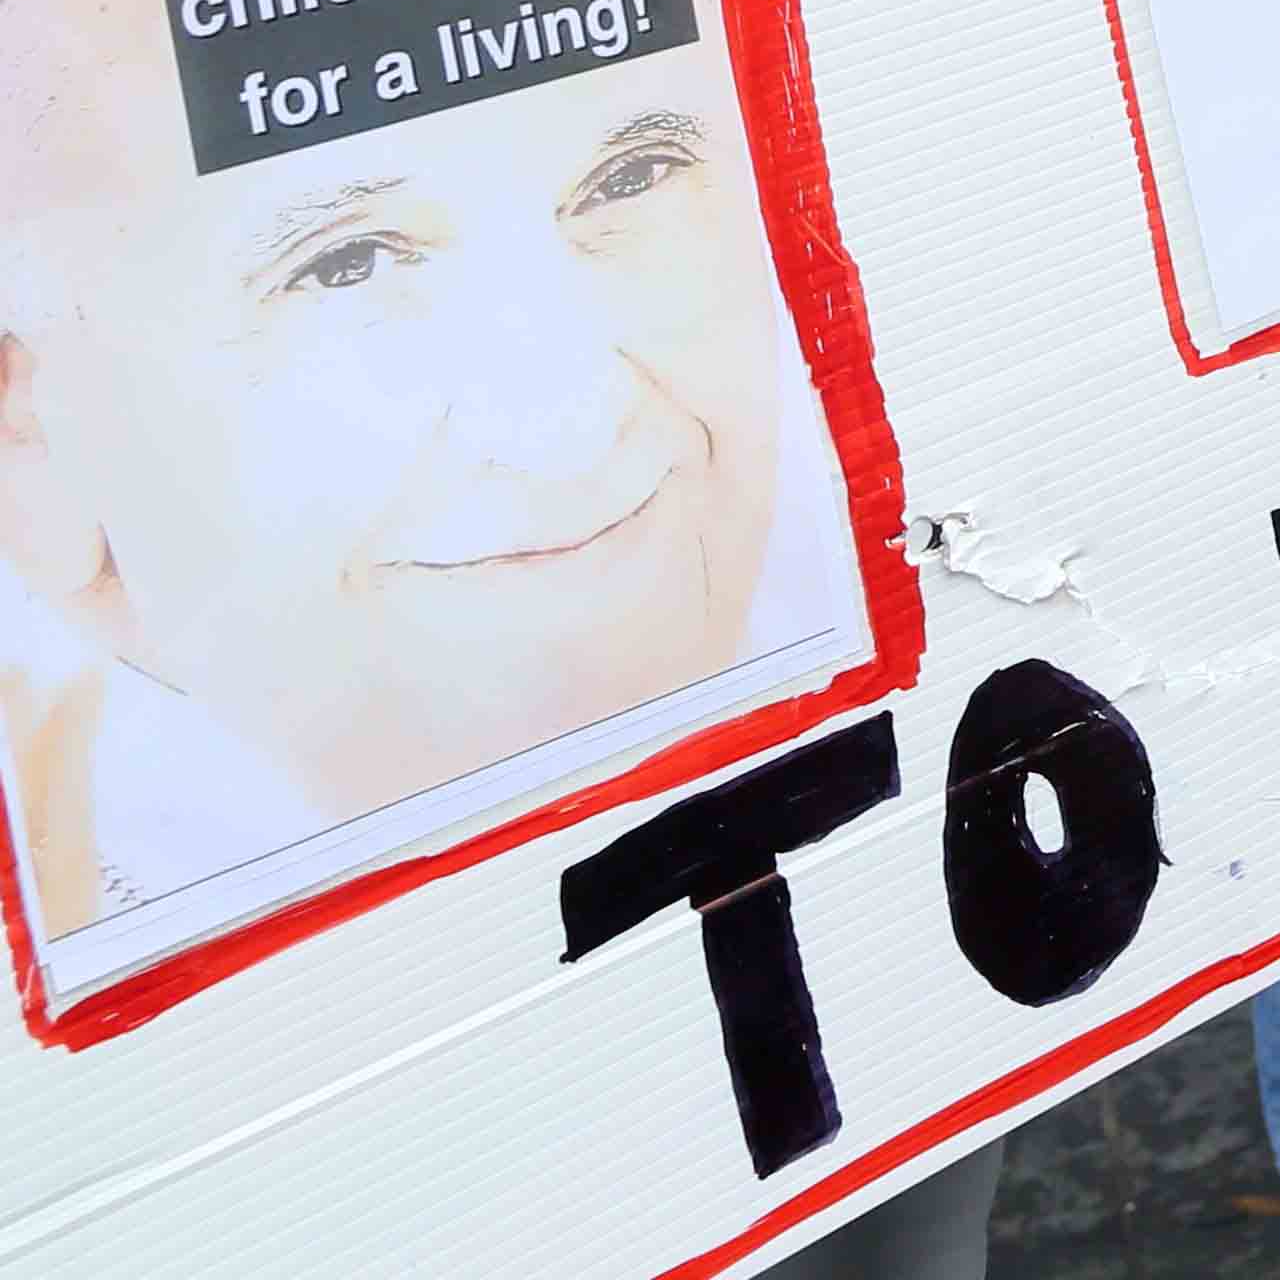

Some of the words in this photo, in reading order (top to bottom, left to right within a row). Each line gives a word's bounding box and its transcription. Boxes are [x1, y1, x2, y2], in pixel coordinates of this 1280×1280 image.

[239, 62, 348, 136] for
[374, 50, 419, 102] a
[558, 657, 1162, 1181] TO
